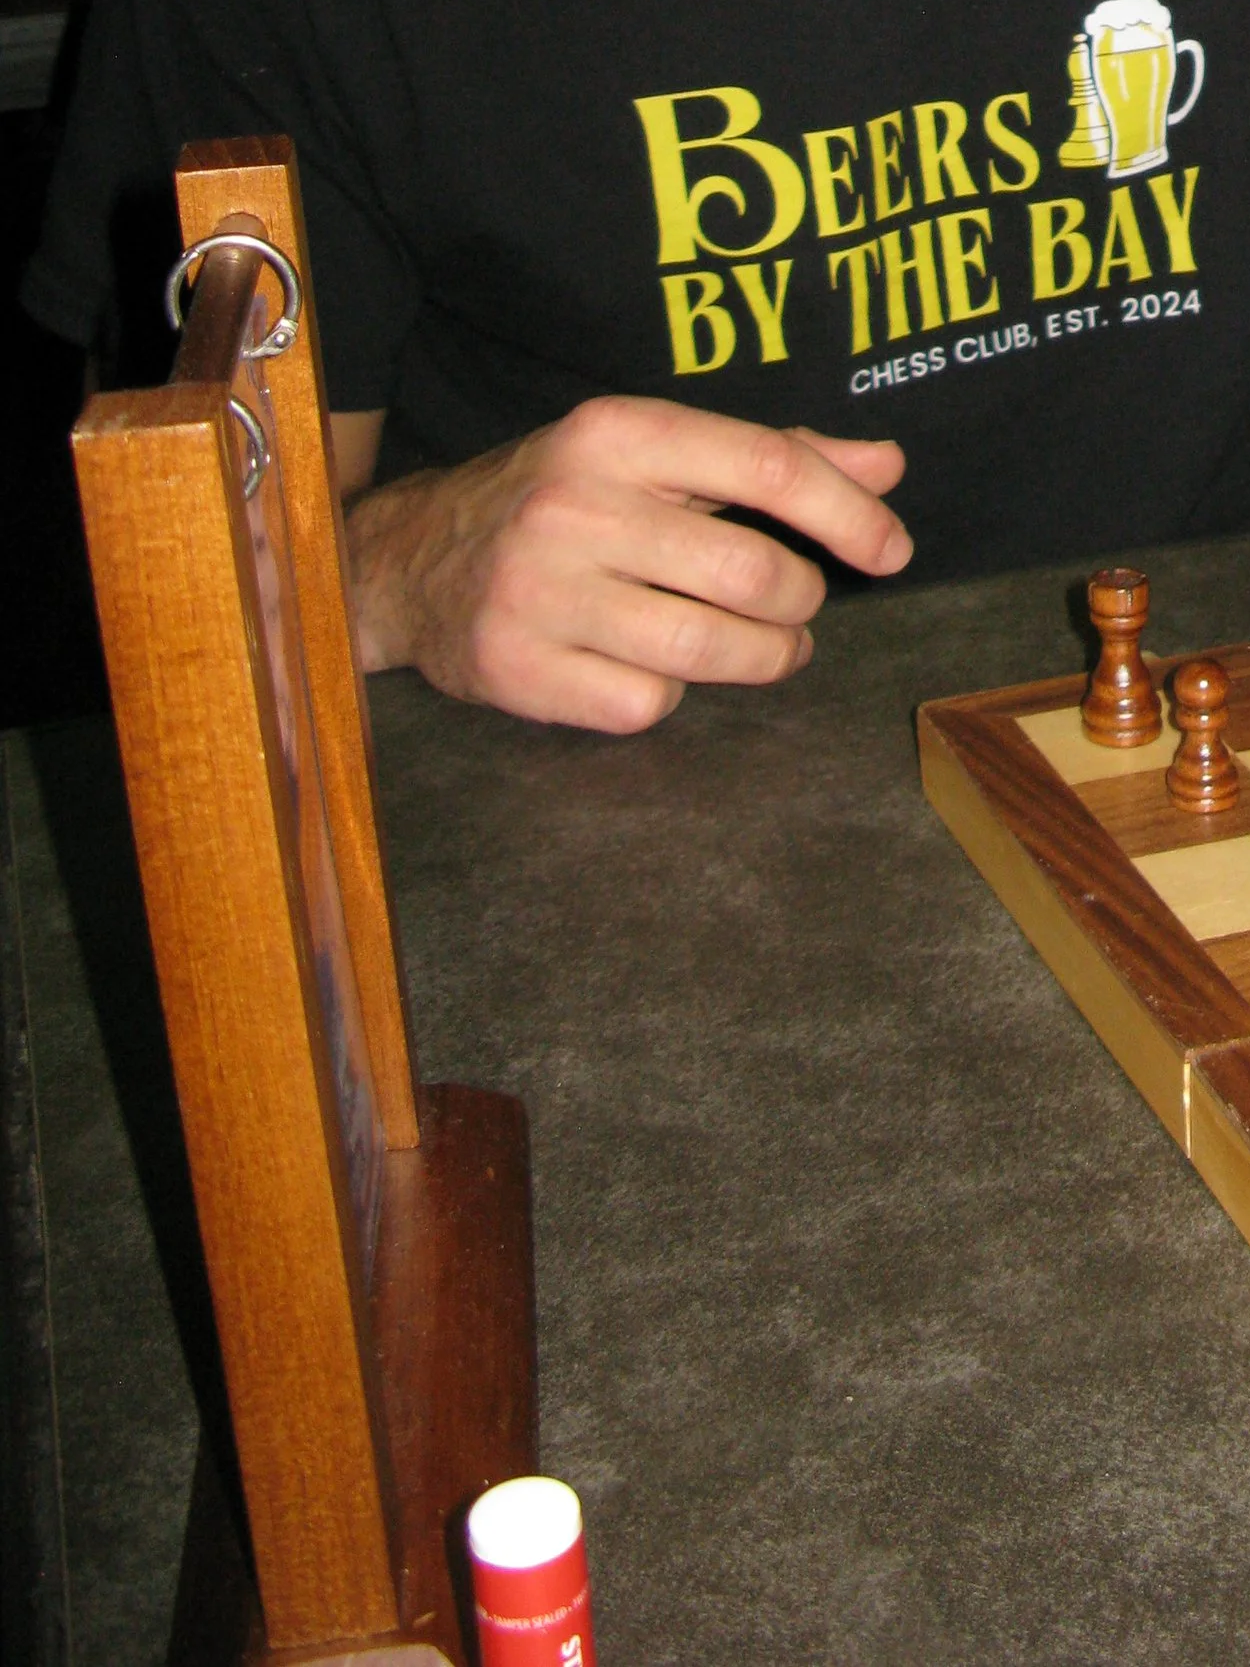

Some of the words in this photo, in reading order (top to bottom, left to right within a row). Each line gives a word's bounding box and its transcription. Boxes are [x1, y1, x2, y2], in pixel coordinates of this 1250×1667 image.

[633, 86, 1042, 265] BEERS
[660, 259, 793, 377] BY
[828, 207, 1001, 356] THE
[1027, 166, 1200, 301] BAY
[849, 349, 947, 395] CHESS
[953, 323, 1039, 365] CLUB,
[1045, 305, 1109, 339] EST.
[1120, 288, 1202, 325] 2024
